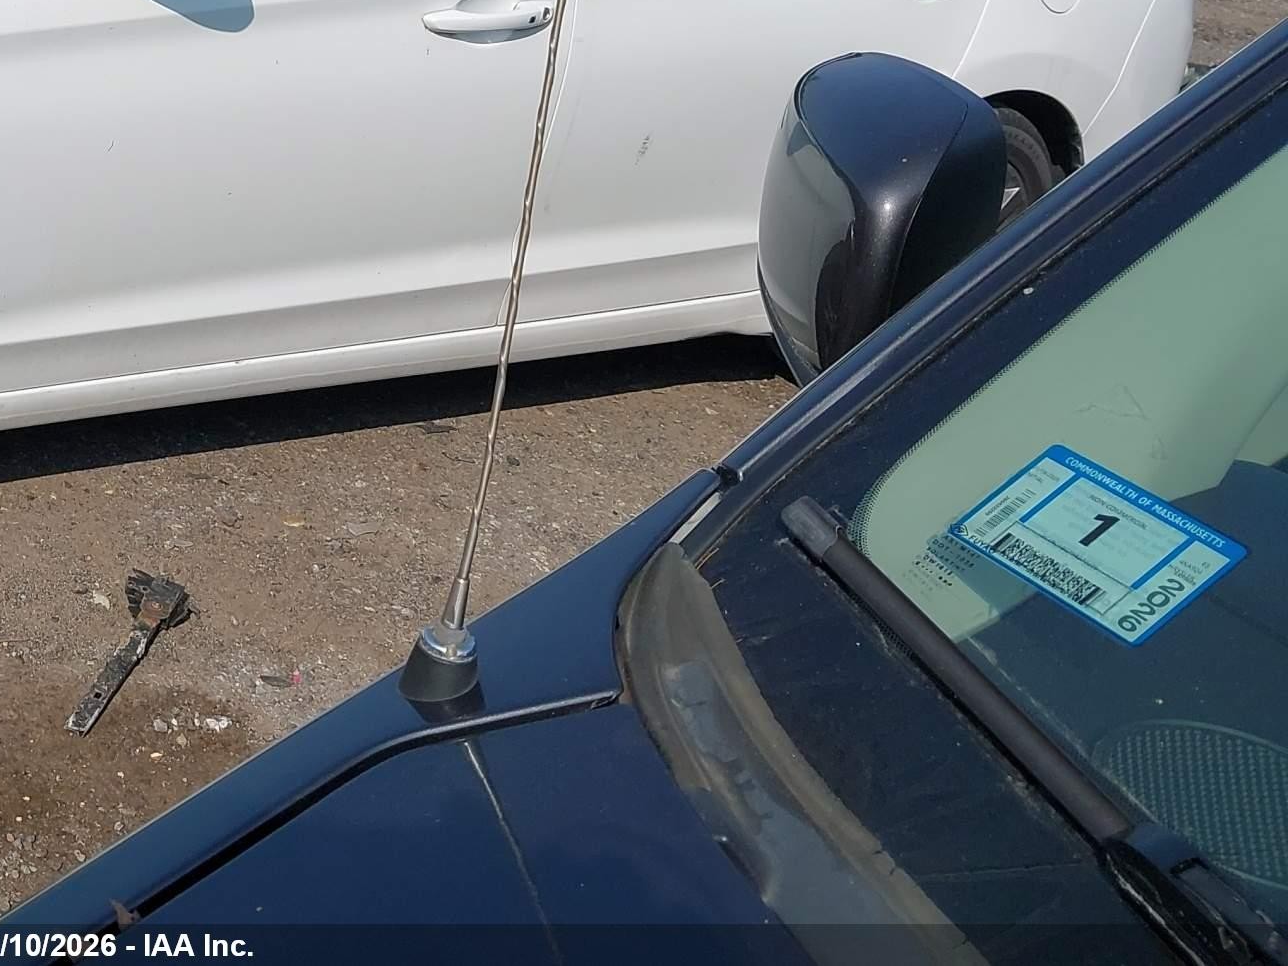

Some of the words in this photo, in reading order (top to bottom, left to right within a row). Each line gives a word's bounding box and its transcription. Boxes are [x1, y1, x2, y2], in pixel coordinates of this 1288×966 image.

[1064, 456, 1139, 501] COMMONWEALTH
[1138, 496, 1153, 507] OF
[1152, 504, 1226, 549] MASSACHUSETTS
[1078, 513, 1121, 547] 1
[1117, 578, 1186, 633] 2026
